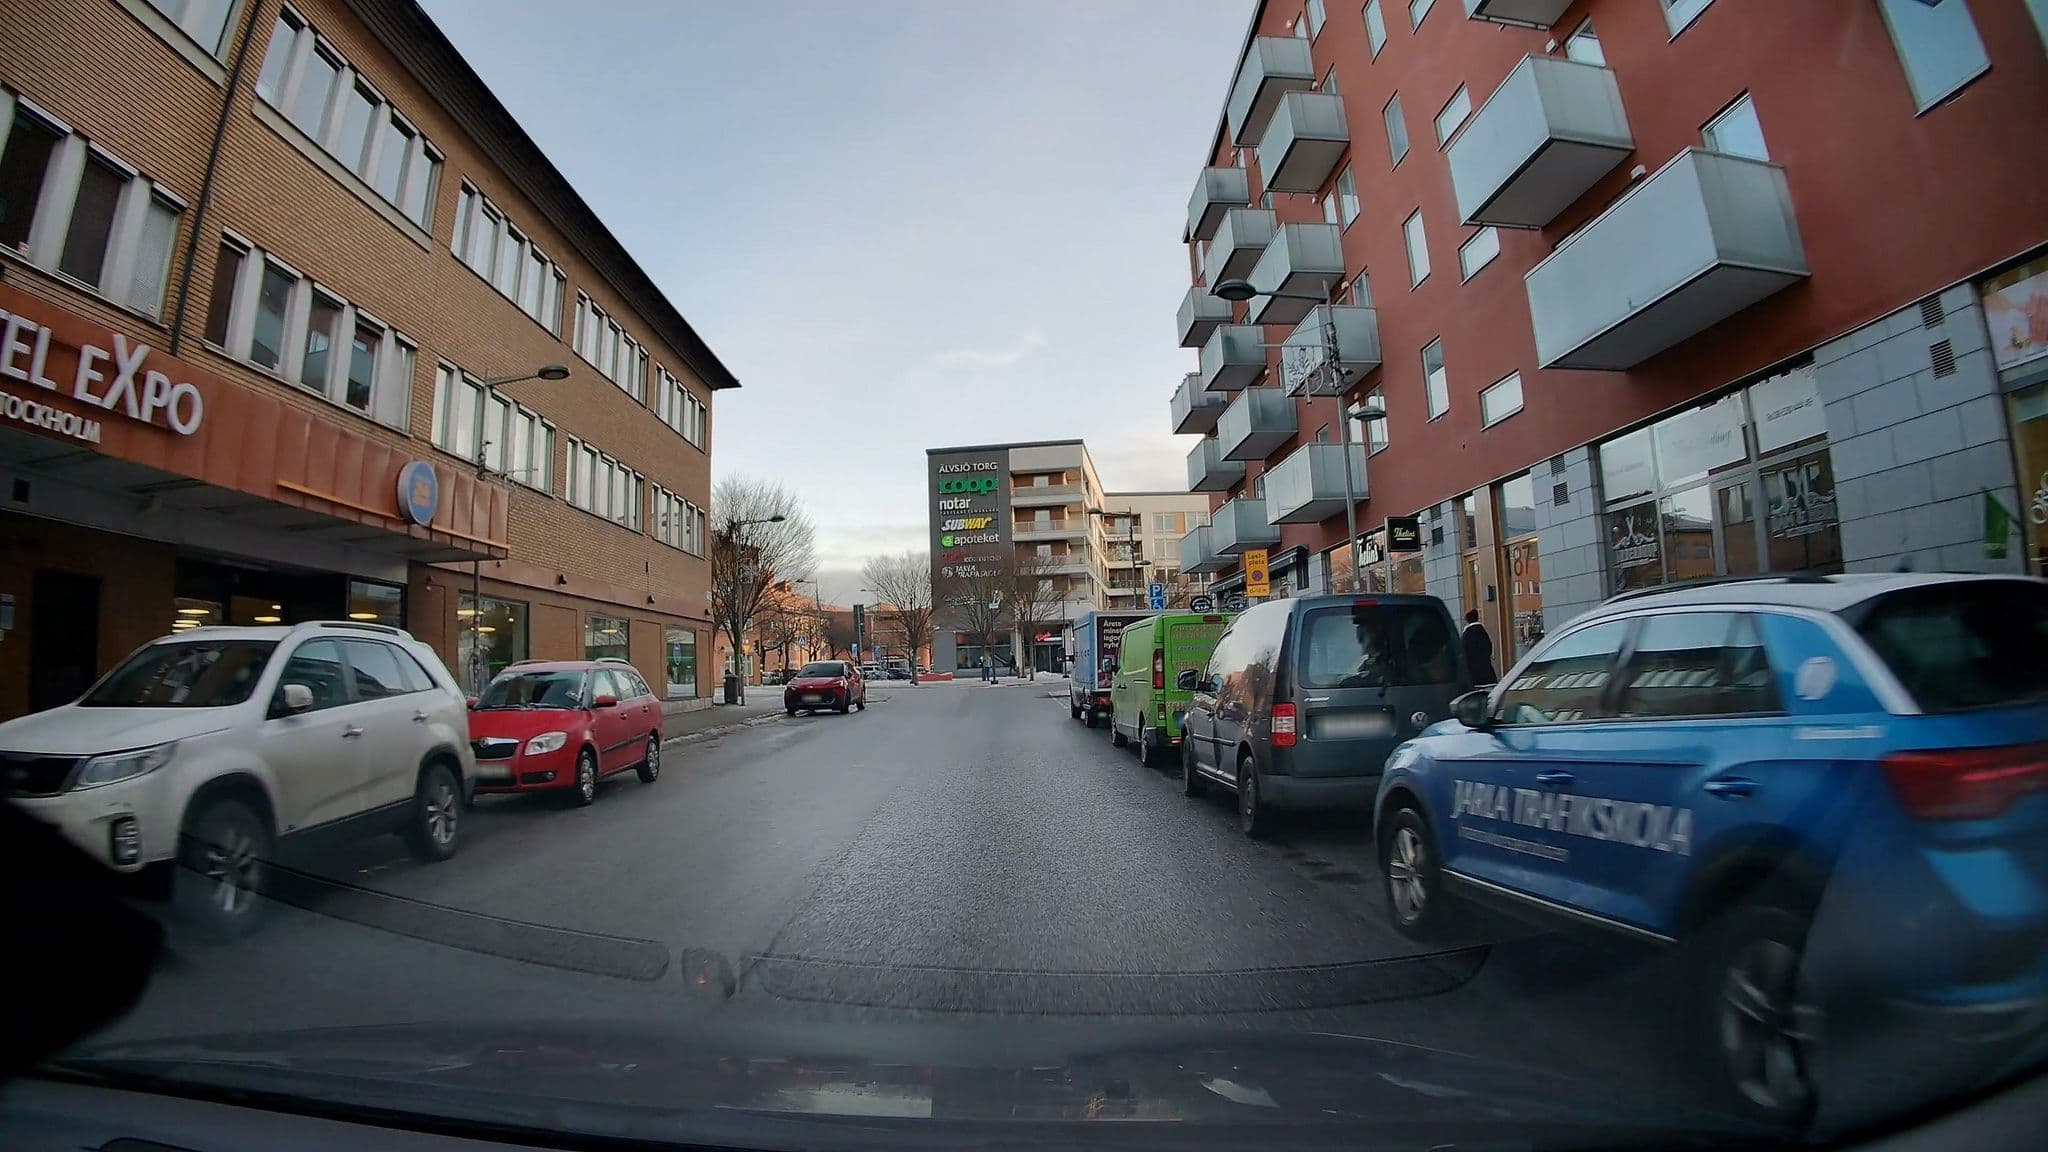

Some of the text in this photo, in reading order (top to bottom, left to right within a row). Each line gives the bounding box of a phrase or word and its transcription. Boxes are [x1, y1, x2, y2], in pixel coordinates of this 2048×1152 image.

[0, 308, 203, 435] EL EXPO
[971, 461, 998, 471] TORG
[939, 478, 999, 496] coop
[939, 497, 971, 510] notar
[941, 516, 993, 531] SUBWAY
[954, 533, 1000, 546] apoteket
